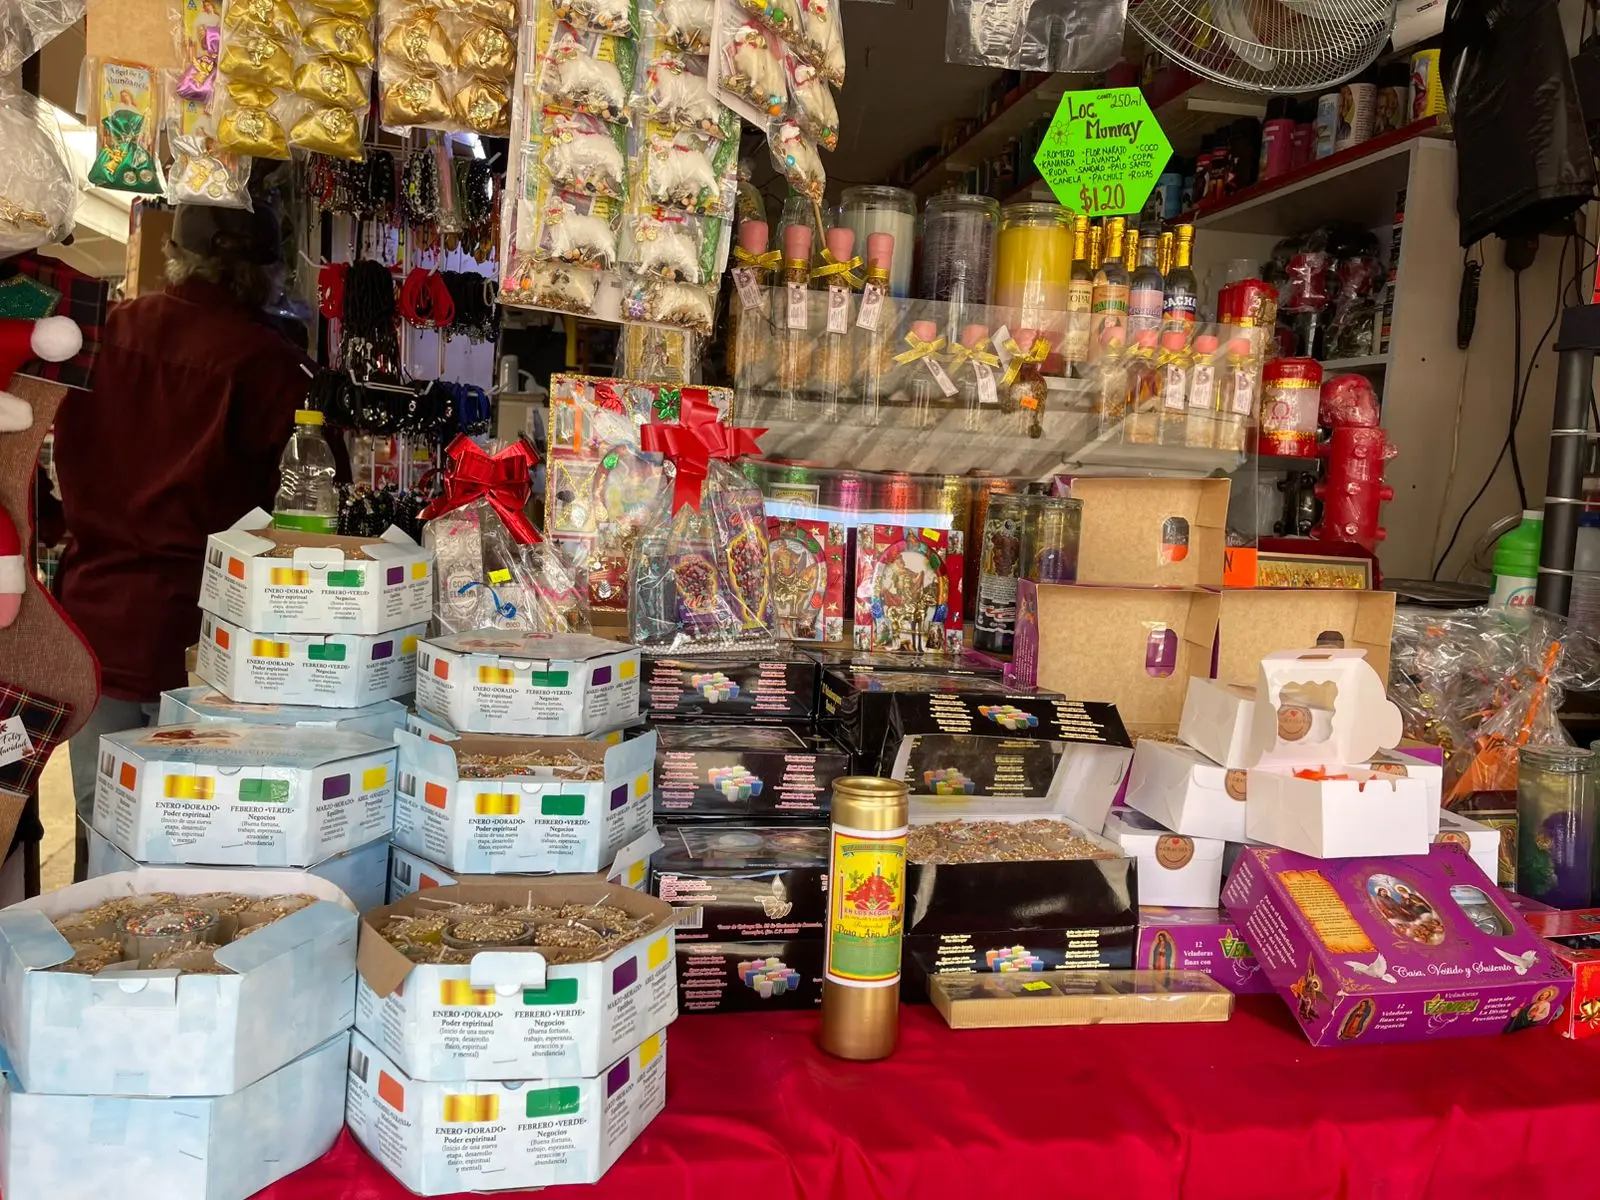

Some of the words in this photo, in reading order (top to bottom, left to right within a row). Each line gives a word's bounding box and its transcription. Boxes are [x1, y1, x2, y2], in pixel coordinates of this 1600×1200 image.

[1111, 95, 1141, 108] 250ml
[1047, 150, 1074, 158] ROMERO
[1086, 156, 1120, 165] LAVANDA
[1053, 176, 1081, 184] CANELA
[1080, 184, 1125, 212] $120
[1465, 967, 1471, 978] y
[515, 1010, 551, 1018] FEBRERO
[462, 1019, 493, 1027] espiritual
[518, 1121, 553, 1131] FEBRERO
[537, 1129, 567, 1138] Negocios
[465, 1135, 496, 1144] espiritual
